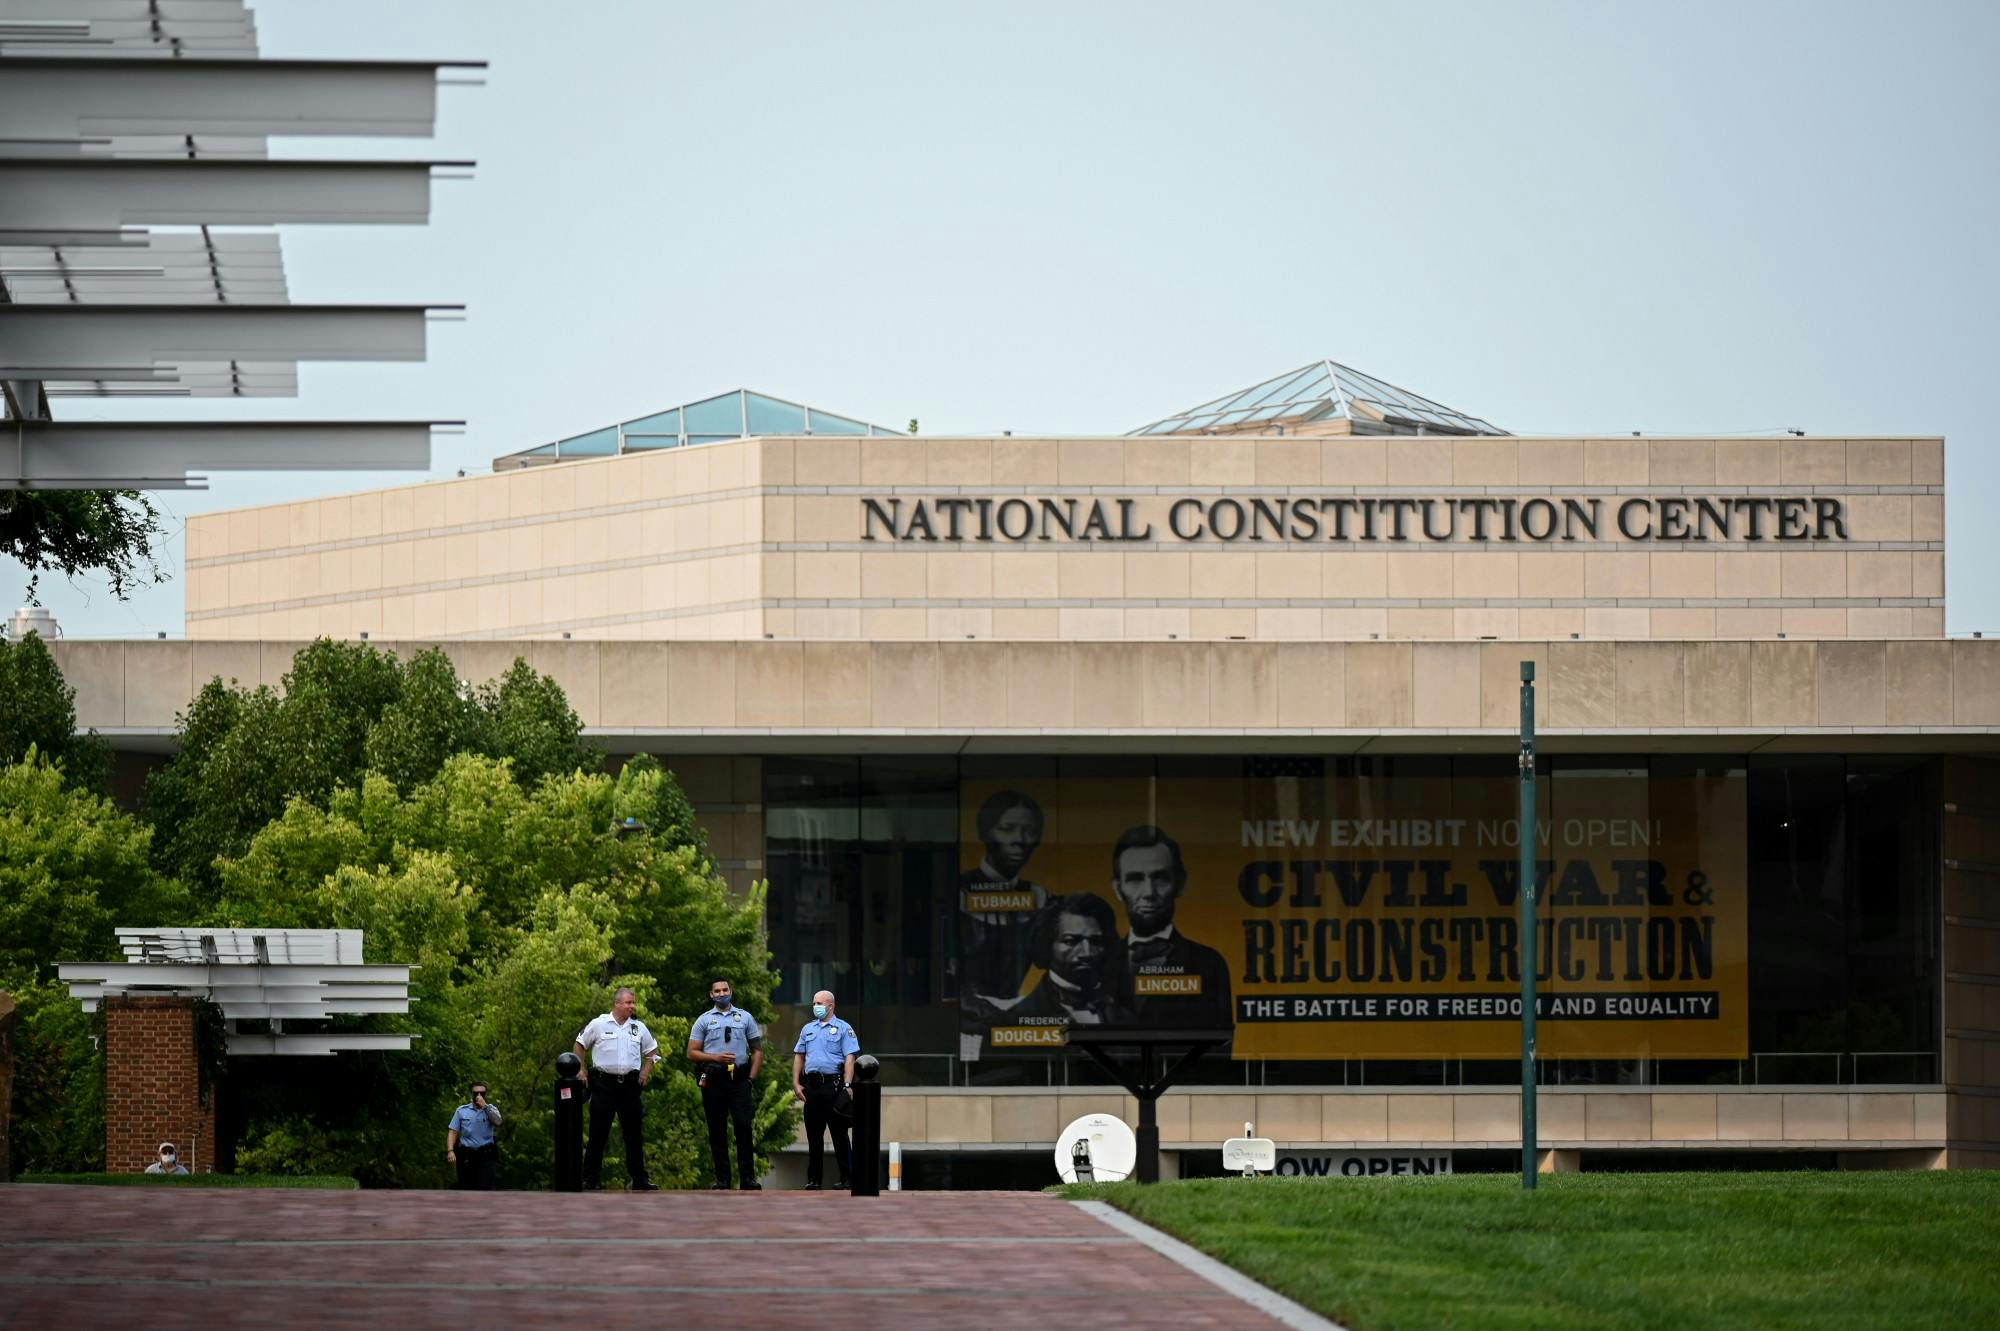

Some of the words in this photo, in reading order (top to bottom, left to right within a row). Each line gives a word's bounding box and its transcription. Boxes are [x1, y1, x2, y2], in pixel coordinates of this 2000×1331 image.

[860, 499, 1151, 541] NATIONAL
[1168, 498, 1600, 541] CONSTITUTION
[1616, 498, 1848, 541] CENTER
[1241, 819, 1319, 848] NEW
[1330, 819, 1467, 847] EXHIBIT
[1563, 819, 1662, 847] OPEN!
[970, 881, 1009, 891] HARRIET
[1238, 860, 1468, 908] CIVIL
[1479, 860, 1674, 906] WAR
[1683, 870, 1714, 906] &
[971, 895, 1032, 909] TUBMAN
[1242, 916, 1714, 984] RECONSTRUCTION
[1138, 965, 1185, 974] ABRAHAM
[1137, 978, 1198, 992] LINCOLN
[1242, 999, 1285, 1018] THE
[1294, 999, 1377, 1017] BATTLE
[1386, 998, 1429, 1016] FOR
[1550, 997, 1596, 1015] AND
[1605, 996, 1713, 1016] EQUALITY
[1018, 1016, 1069, 1025] FREDERICK
[994, 1029, 1066, 1043] DOUGLAS
[1260, 1157, 1332, 1177] OW
[1341, 1157, 1448, 1177] OPEN!
